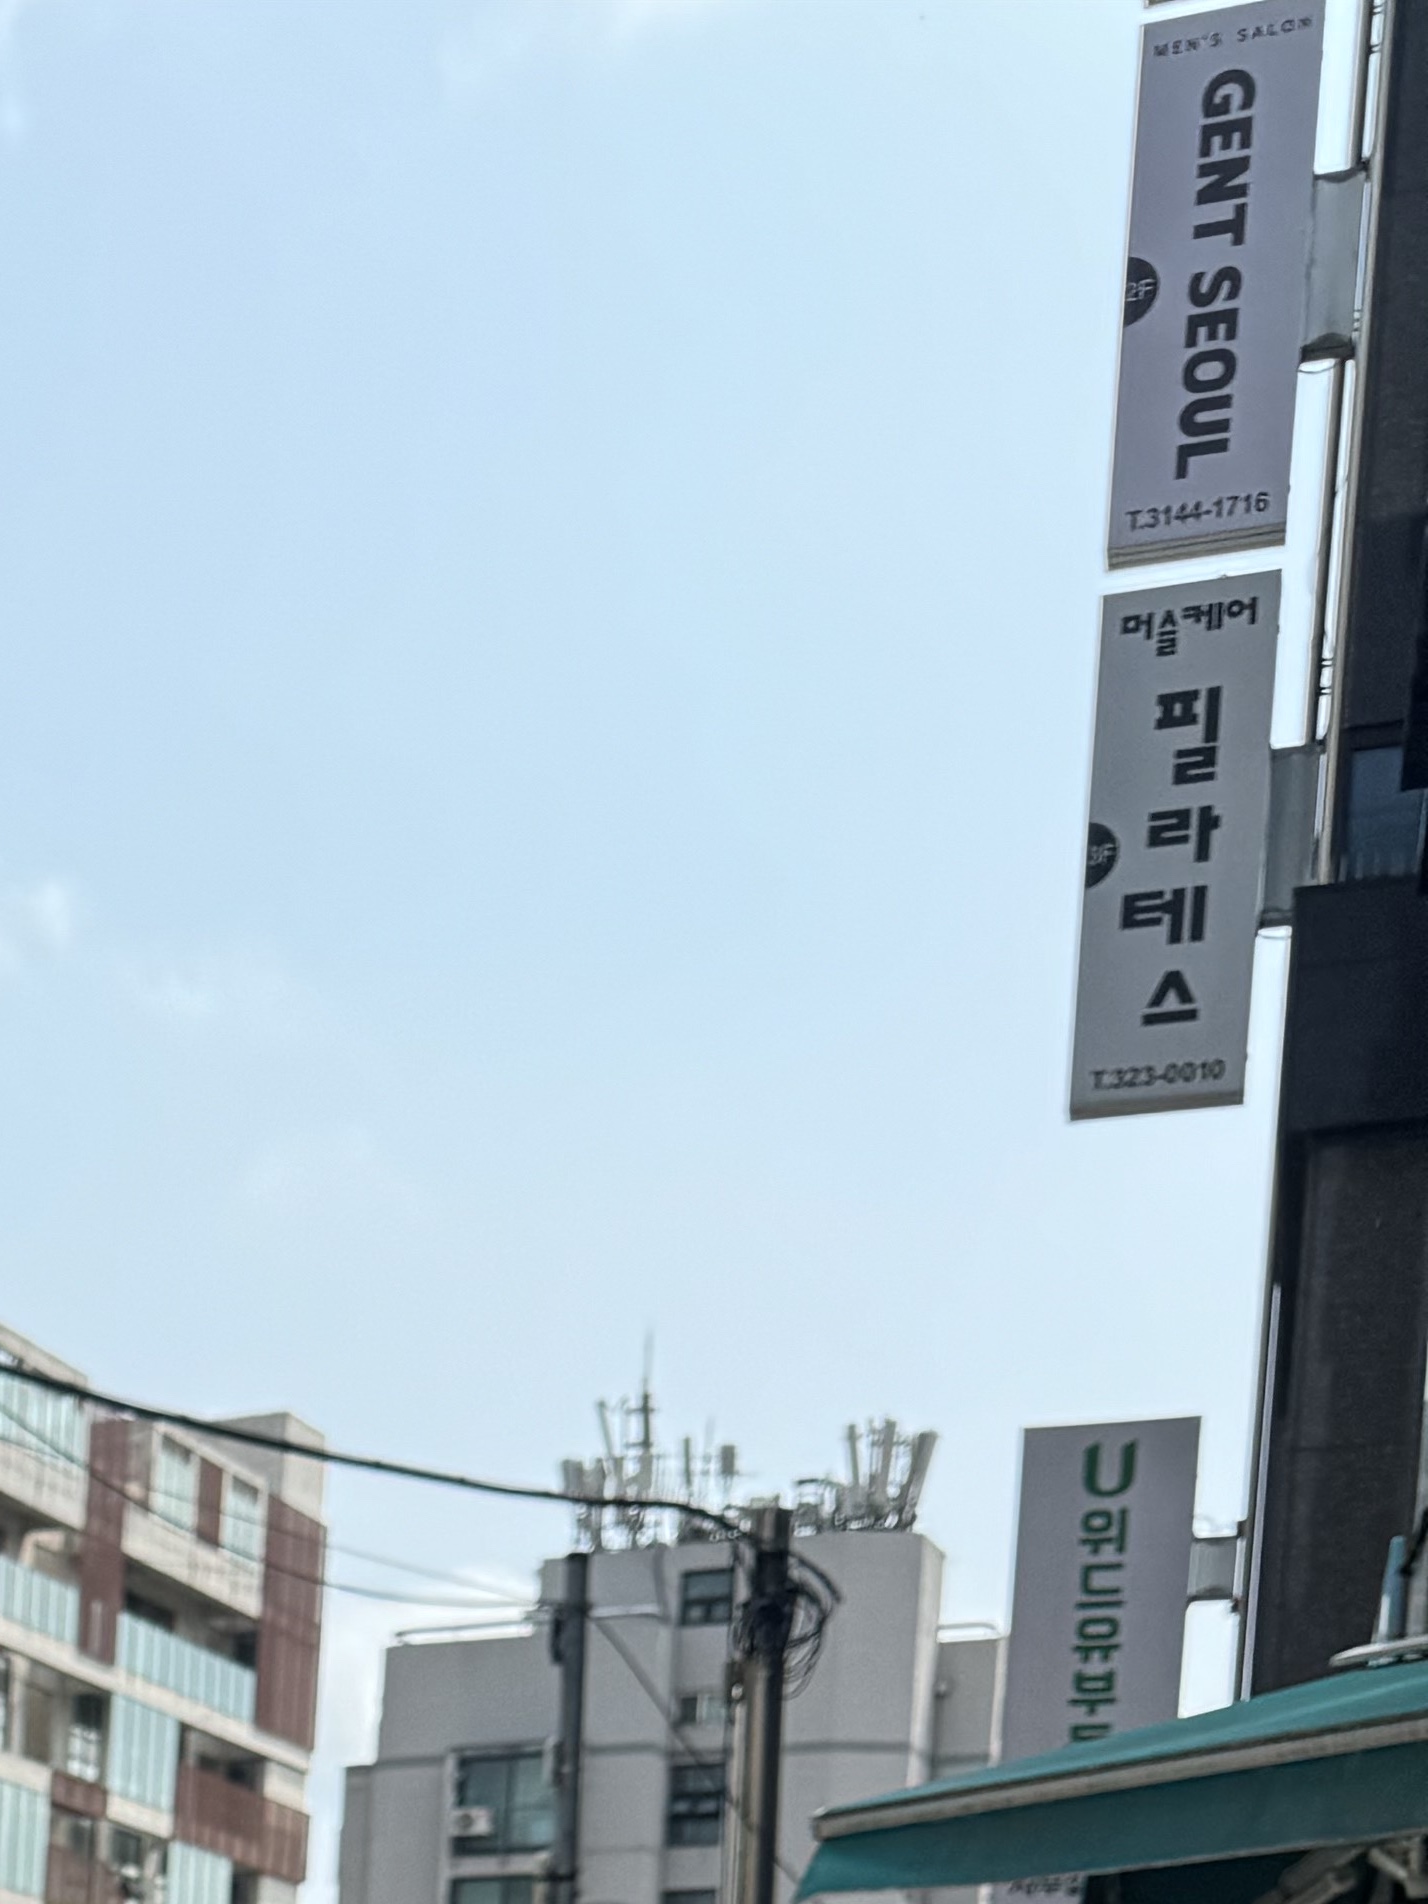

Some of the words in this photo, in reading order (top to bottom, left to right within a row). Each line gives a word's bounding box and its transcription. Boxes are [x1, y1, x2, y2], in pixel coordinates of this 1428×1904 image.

[1152, 31, 1224, 58] MEN'S
[1236, 14, 1314, 44] SALON
[1191, 67, 1257, 248] GENT
[1173, 264, 1243, 481] SEOUL
[1119, 595, 1260, 658] 머슬케어
[1117, 685, 1223, 1028] 필라테스
